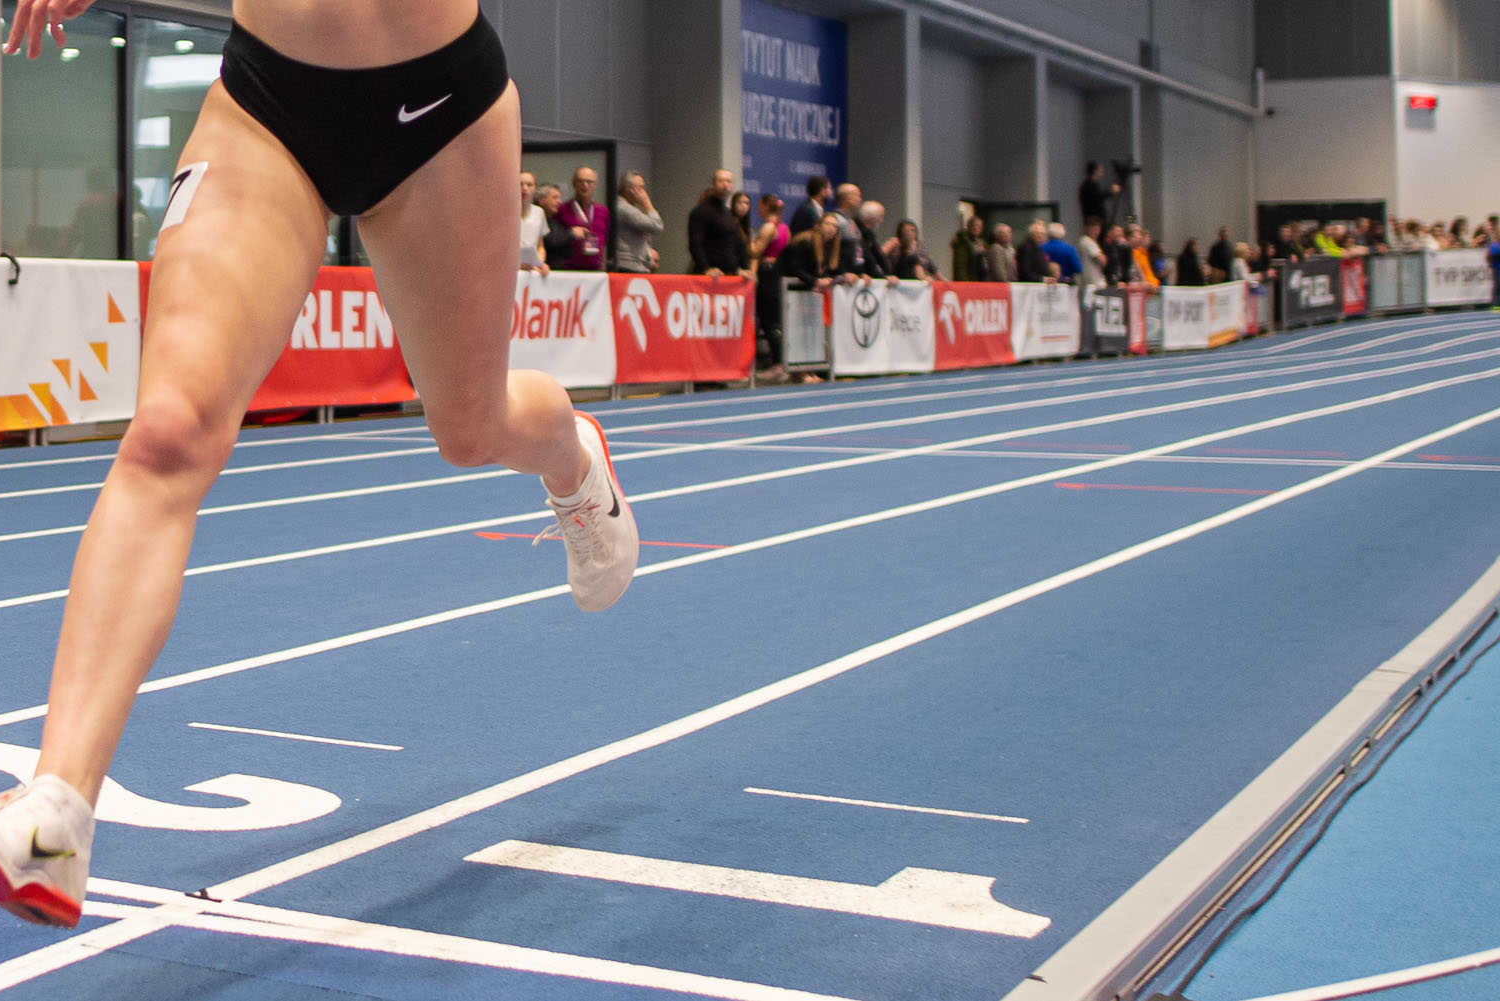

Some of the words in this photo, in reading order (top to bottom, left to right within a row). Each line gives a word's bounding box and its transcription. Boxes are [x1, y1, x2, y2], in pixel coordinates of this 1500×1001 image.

[741, 29, 784, 78] TYTUT
[741, 90, 776, 138] URZE
[290, 290, 394, 349] RLEN
[666, 290, 745, 339] ORLEN
[964, 299, 1008, 335] ORLEN
[462, 839, 1052, 939] 1
